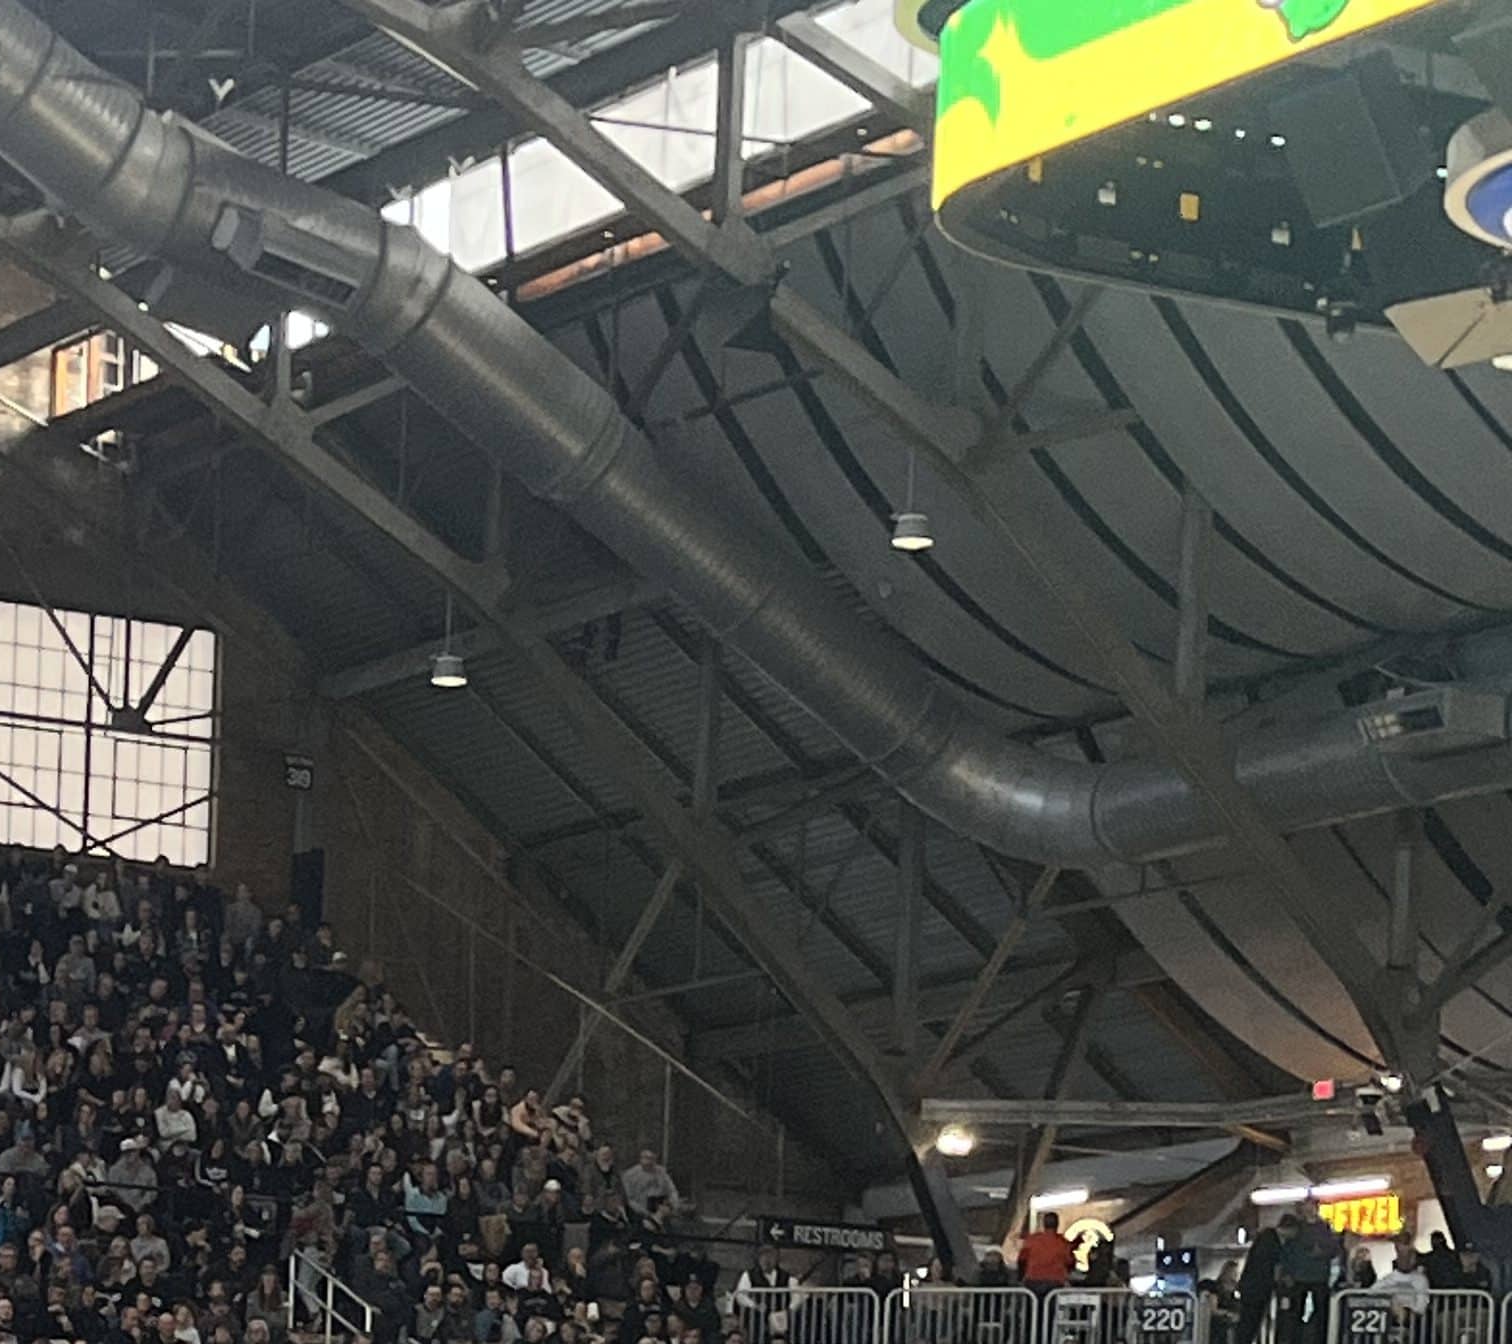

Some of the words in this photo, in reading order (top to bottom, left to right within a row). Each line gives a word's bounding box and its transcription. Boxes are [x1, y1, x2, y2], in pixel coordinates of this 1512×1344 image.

[793, 1225, 883, 1249] RESTROOMS
[1142, 1308, 1185, 1331] 220
[1351, 1310, 1387, 1333] 221
